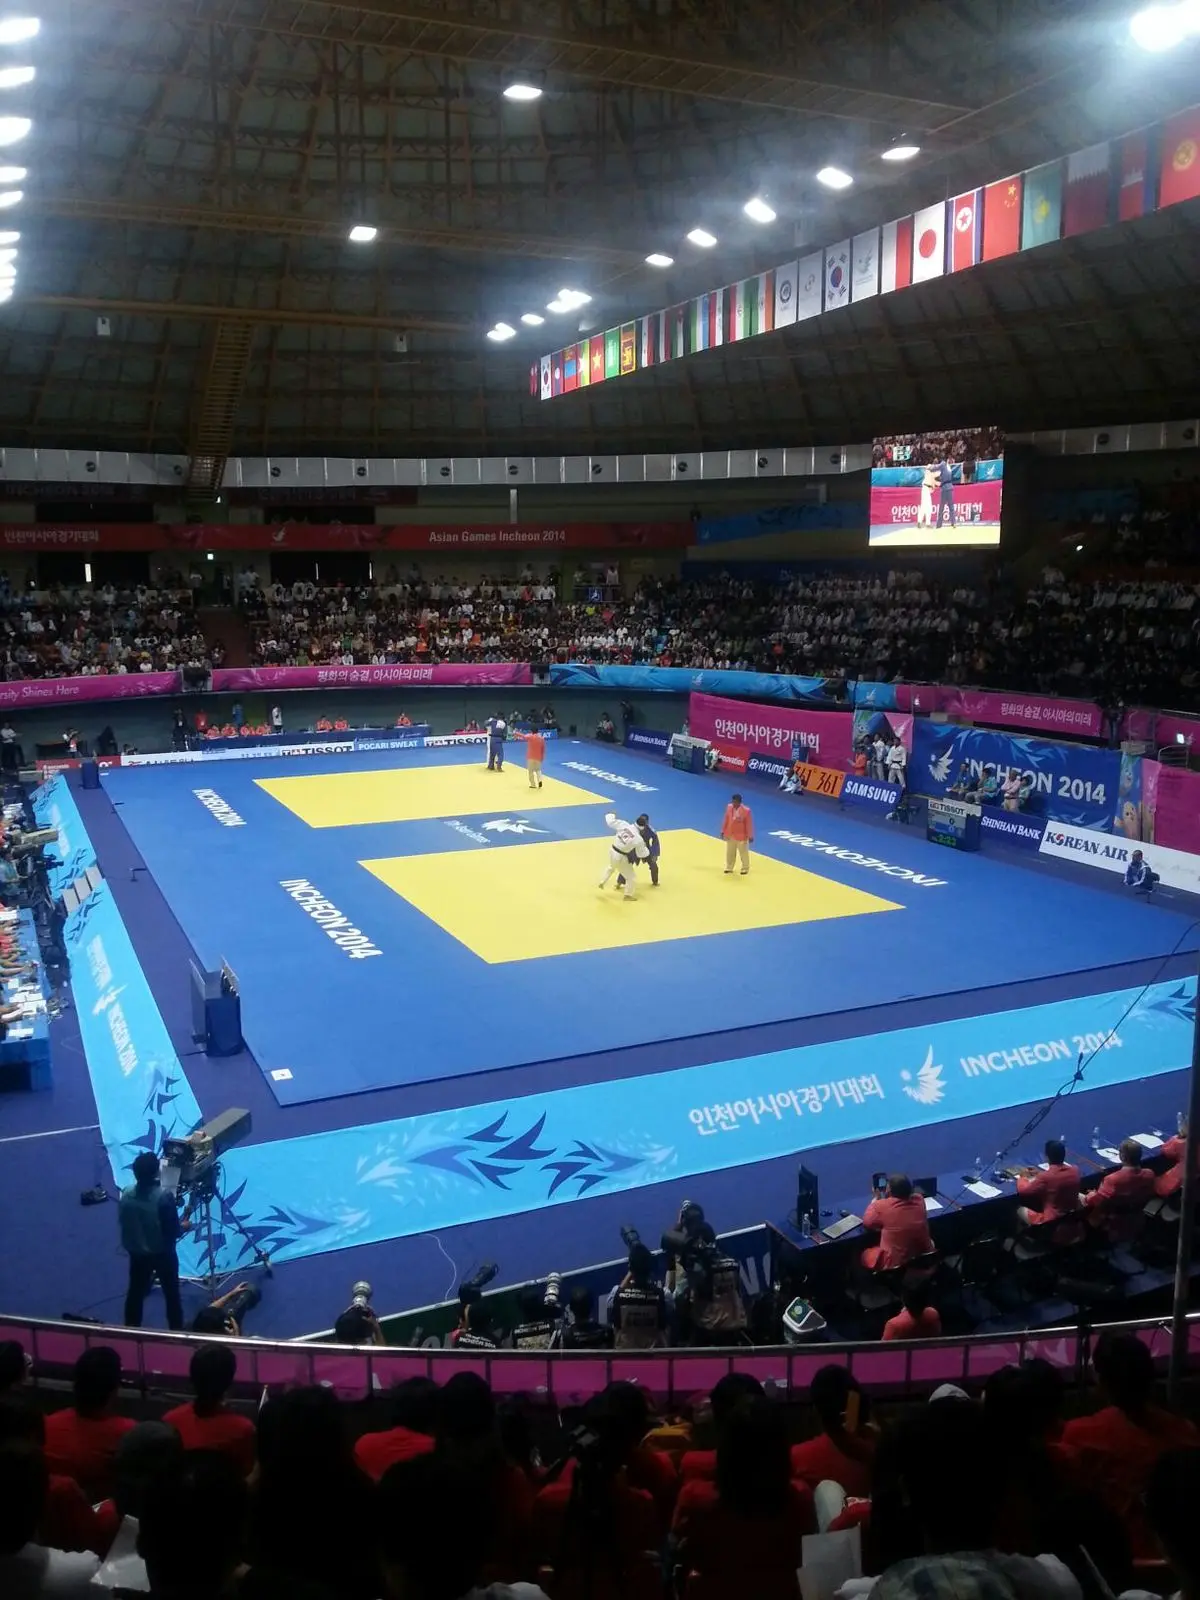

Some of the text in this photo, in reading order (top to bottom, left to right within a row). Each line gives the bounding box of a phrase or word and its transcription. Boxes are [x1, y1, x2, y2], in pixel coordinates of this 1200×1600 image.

[429, 529, 566, 542] Asian Games Incheon 2014
[22, 685, 53, 698] Shines
[56, 684, 80, 696] Here
[358, 740, 418, 751] POCARI SWEAT
[715, 719, 819, 754] 인천아시아경기대회
[759, 761, 790, 775] HYUNDA
[845, 780, 897, 804] SAMSUNG
[965, 757, 1106, 804] NHON 2014
[940, 803, 965, 816] TISSOT
[981, 815, 1041, 839] SHINHAN BANK
[768, 830, 949, 887] INCHEON 2014
[1045, 831, 1128, 862] KOREAN AIR
[279, 879, 384, 959] INCHEON 2014
[959, 1029, 1123, 1077] INCHEON 2014
[689, 1073, 885, 1136] 인천아시아경기대회
[459, 1336, 484, 1346] INCHEON
